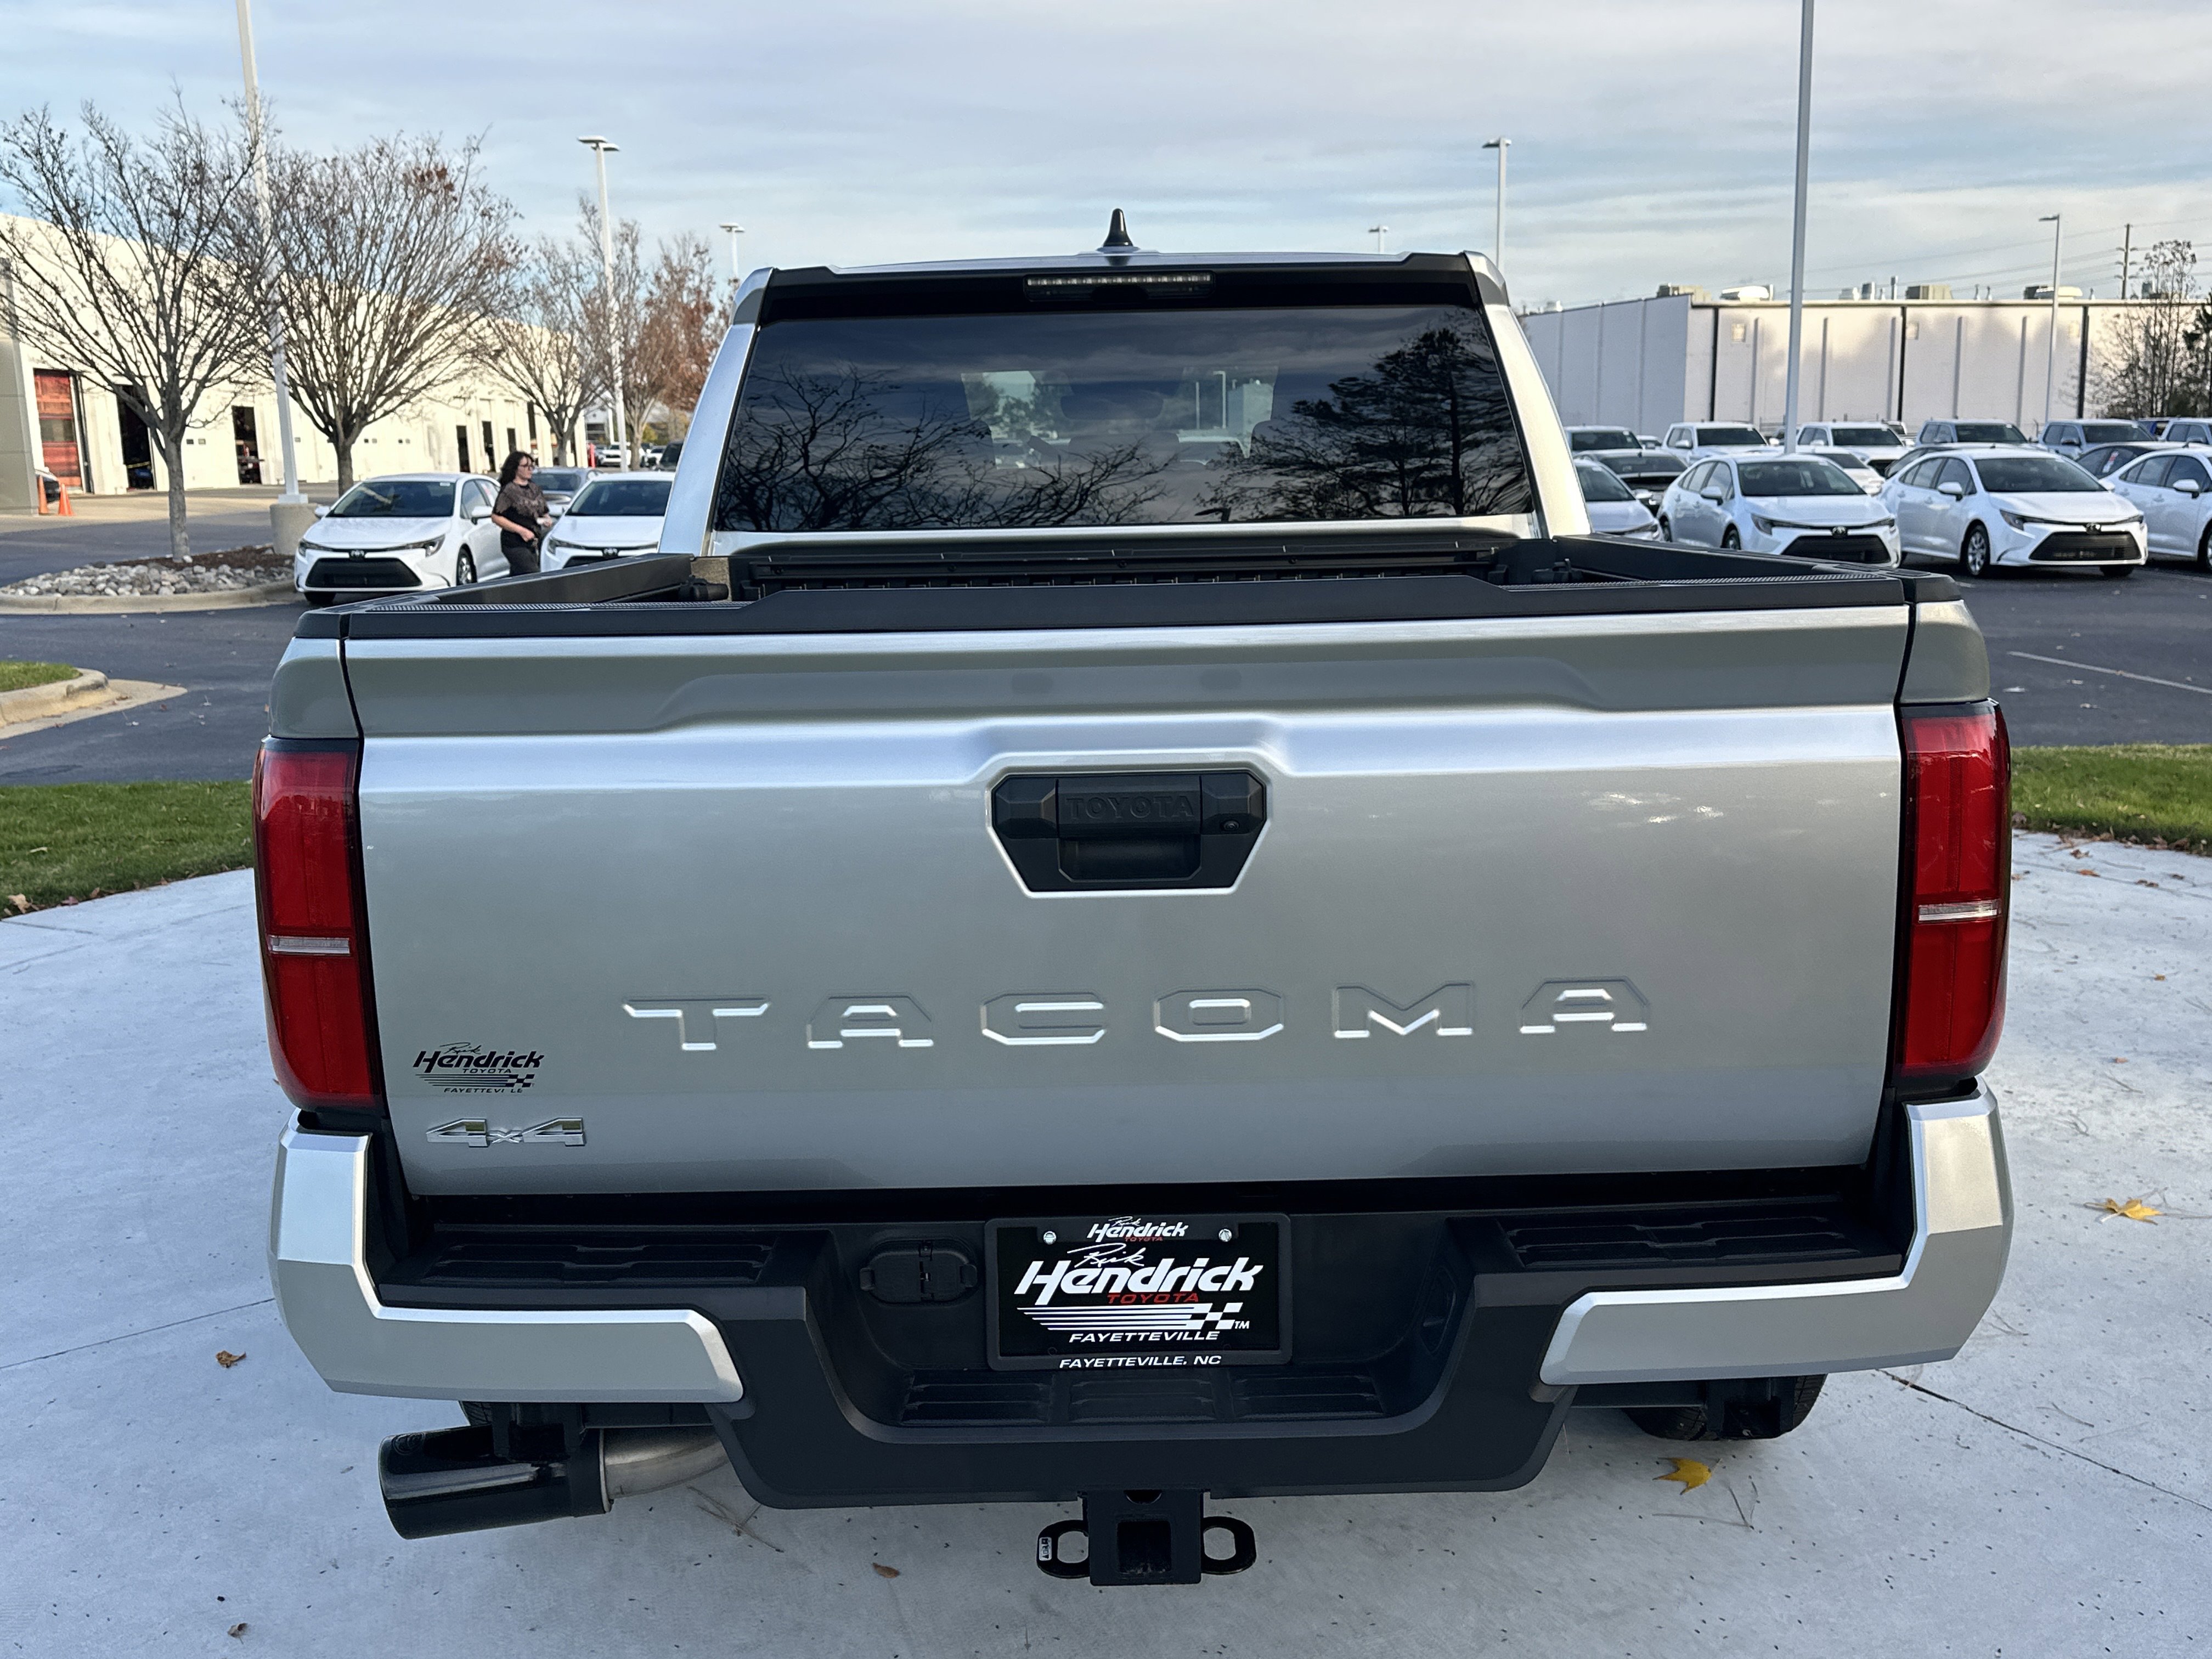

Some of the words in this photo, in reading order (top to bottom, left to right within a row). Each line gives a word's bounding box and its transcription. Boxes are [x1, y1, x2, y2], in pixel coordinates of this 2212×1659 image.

[1065, 796, 1194, 819] TOYOTA
[623, 975, 1649, 1052] TACOMA
[413, 1050, 545, 1074] Hendrick
[1086, 1221, 1189, 1243] Hendrick
[1014, 1257, 1263, 1306] Hendrick
[1107, 1292, 1199, 1304] TOYOTA
[1234, 1321, 1250, 1329] TM
[1069, 1331, 1220, 1343] FAYETTEVILLE
[1193, 1355, 1222, 1365] NC
